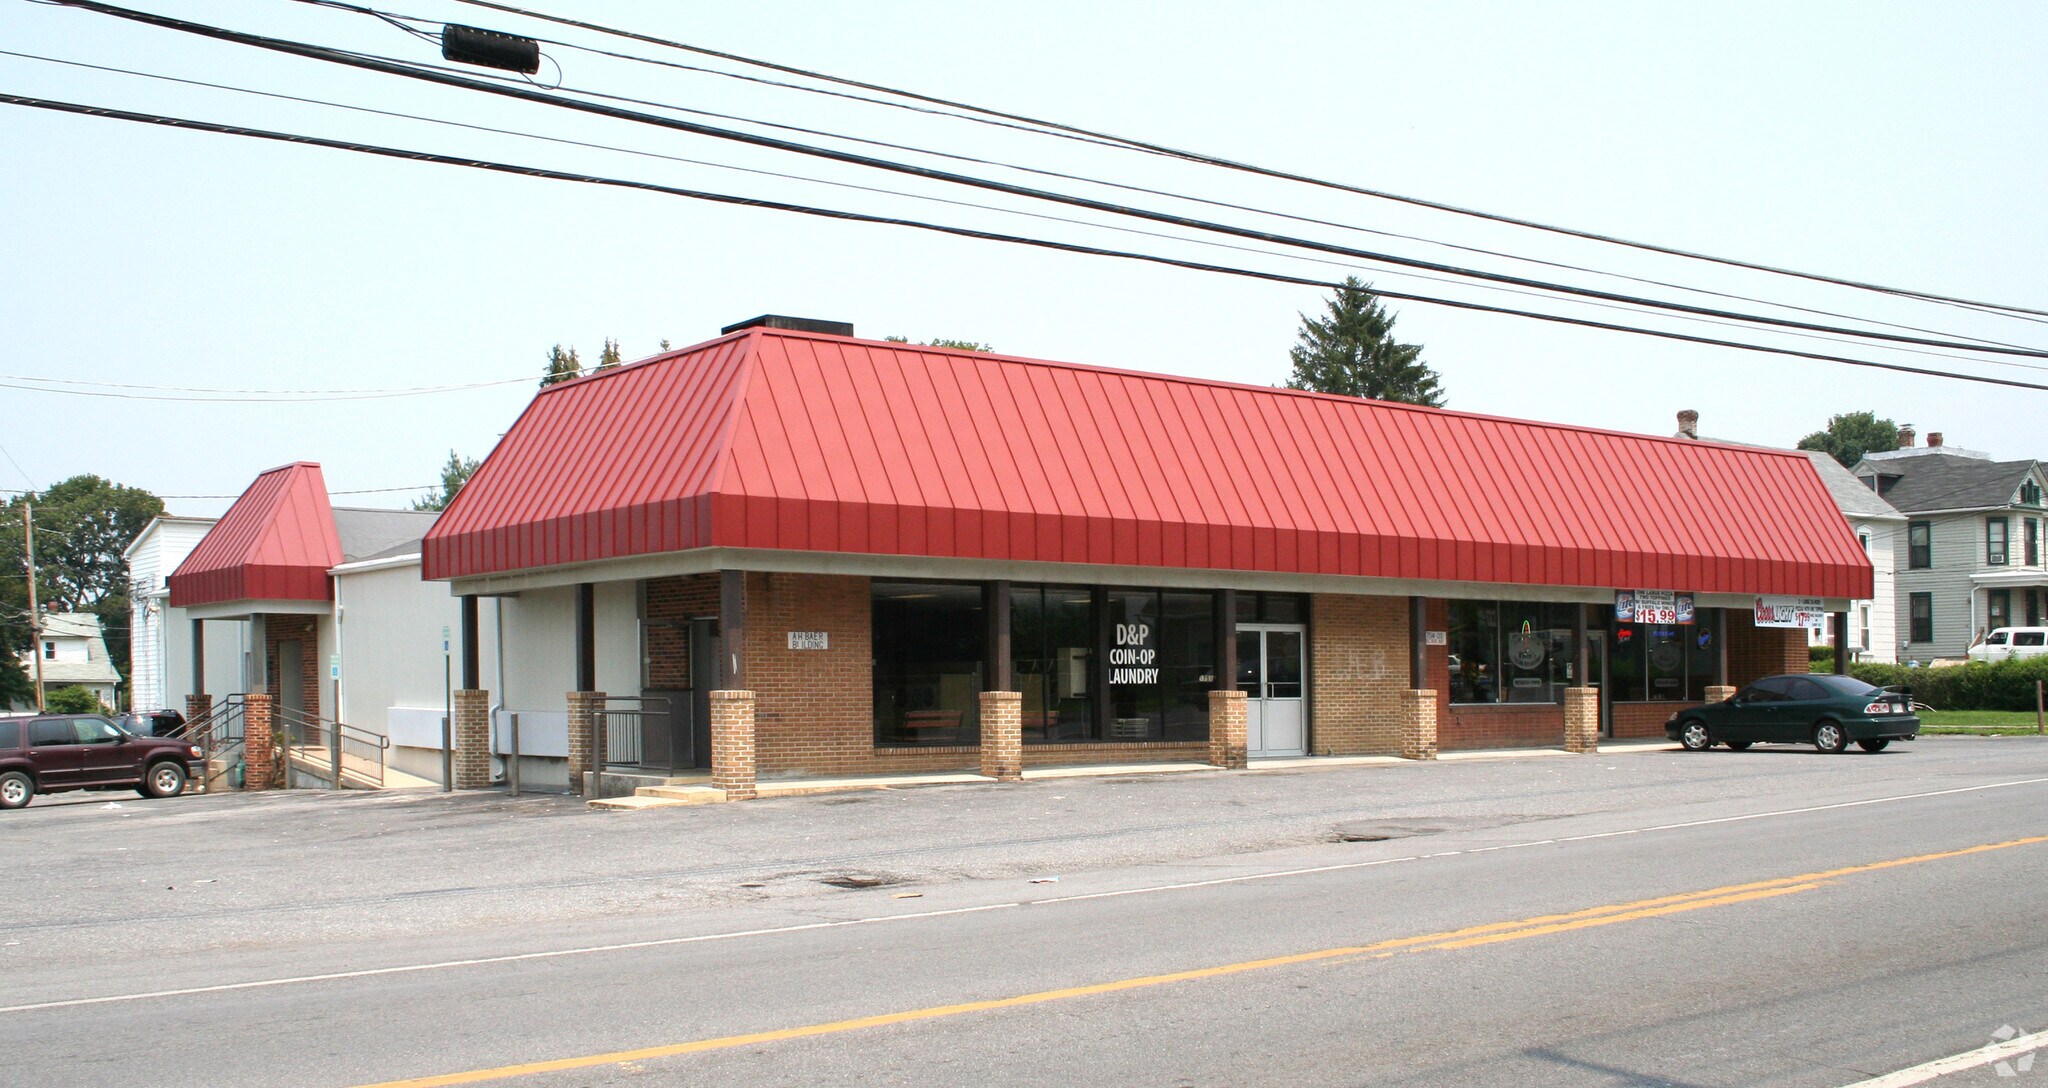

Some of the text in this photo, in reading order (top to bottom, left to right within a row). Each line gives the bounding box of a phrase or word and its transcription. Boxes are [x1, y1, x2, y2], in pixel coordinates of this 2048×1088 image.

[1636, 609, 1675, 623] $15.99
[1774, 606, 1794, 622] LIGHT
[805, 632, 824, 640] BAER
[1116, 624, 1149, 645] D&P
[1109, 648, 1155, 664] COIN-OP
[1108, 668, 1159, 684] LAUNDRY
